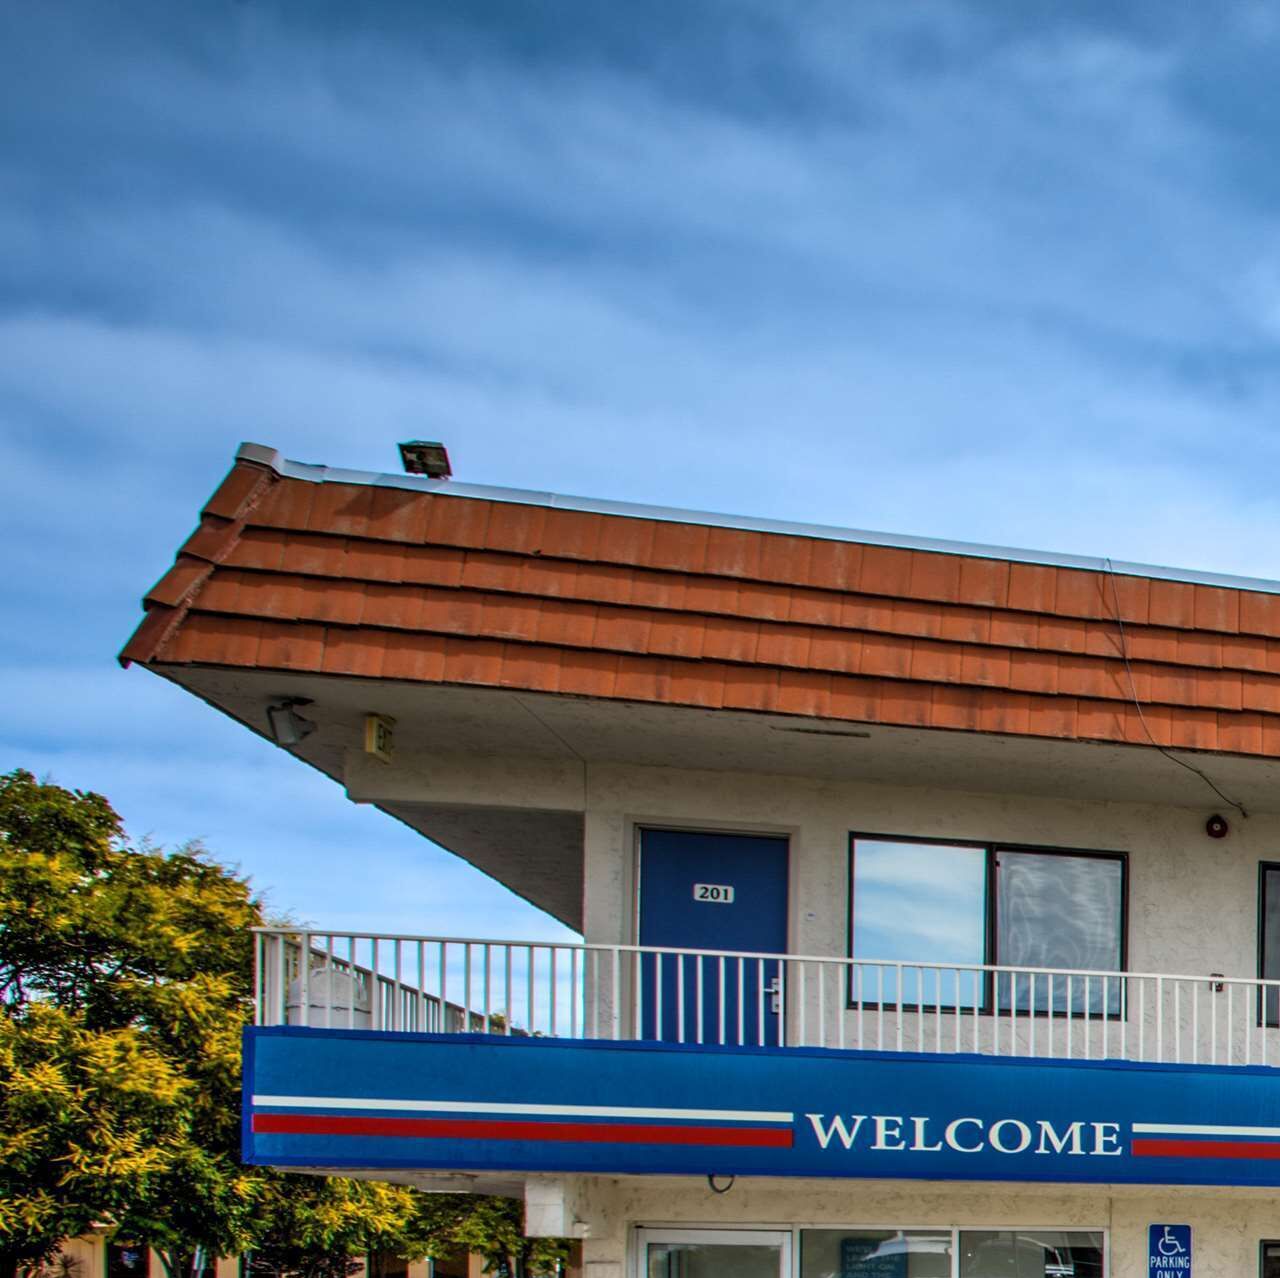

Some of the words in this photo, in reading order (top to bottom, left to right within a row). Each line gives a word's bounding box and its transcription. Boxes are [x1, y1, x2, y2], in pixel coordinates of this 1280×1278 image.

[698, 886, 729, 901] 201
[805, 1113, 1123, 1156] WELCOME
[1150, 1256, 1190, 1269] PARKING
